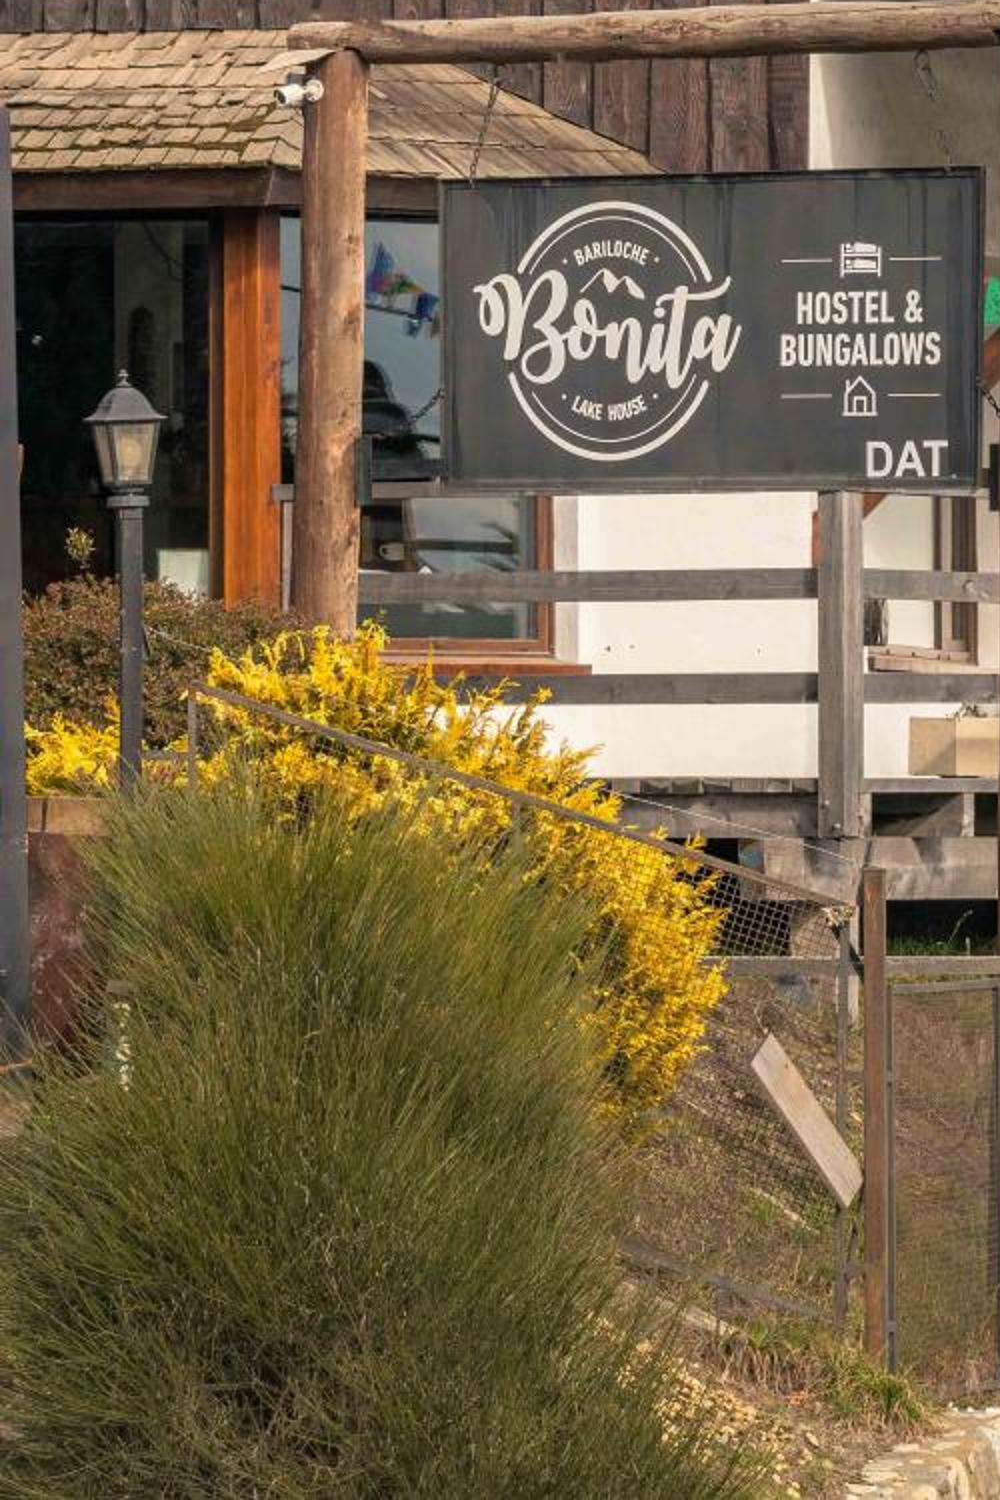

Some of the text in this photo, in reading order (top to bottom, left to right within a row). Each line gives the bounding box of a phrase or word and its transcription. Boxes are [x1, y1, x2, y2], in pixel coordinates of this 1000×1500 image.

[572, 239, 650, 267] BARILOCHE
[796, 289, 924, 325] HOSTEL &
[472, 268, 743, 390] Bonita
[779, 331, 942, 368] BUNGALOWS
[571, 393, 648, 421] LAKE HOUSE
[865, 439, 949, 478] DAT
